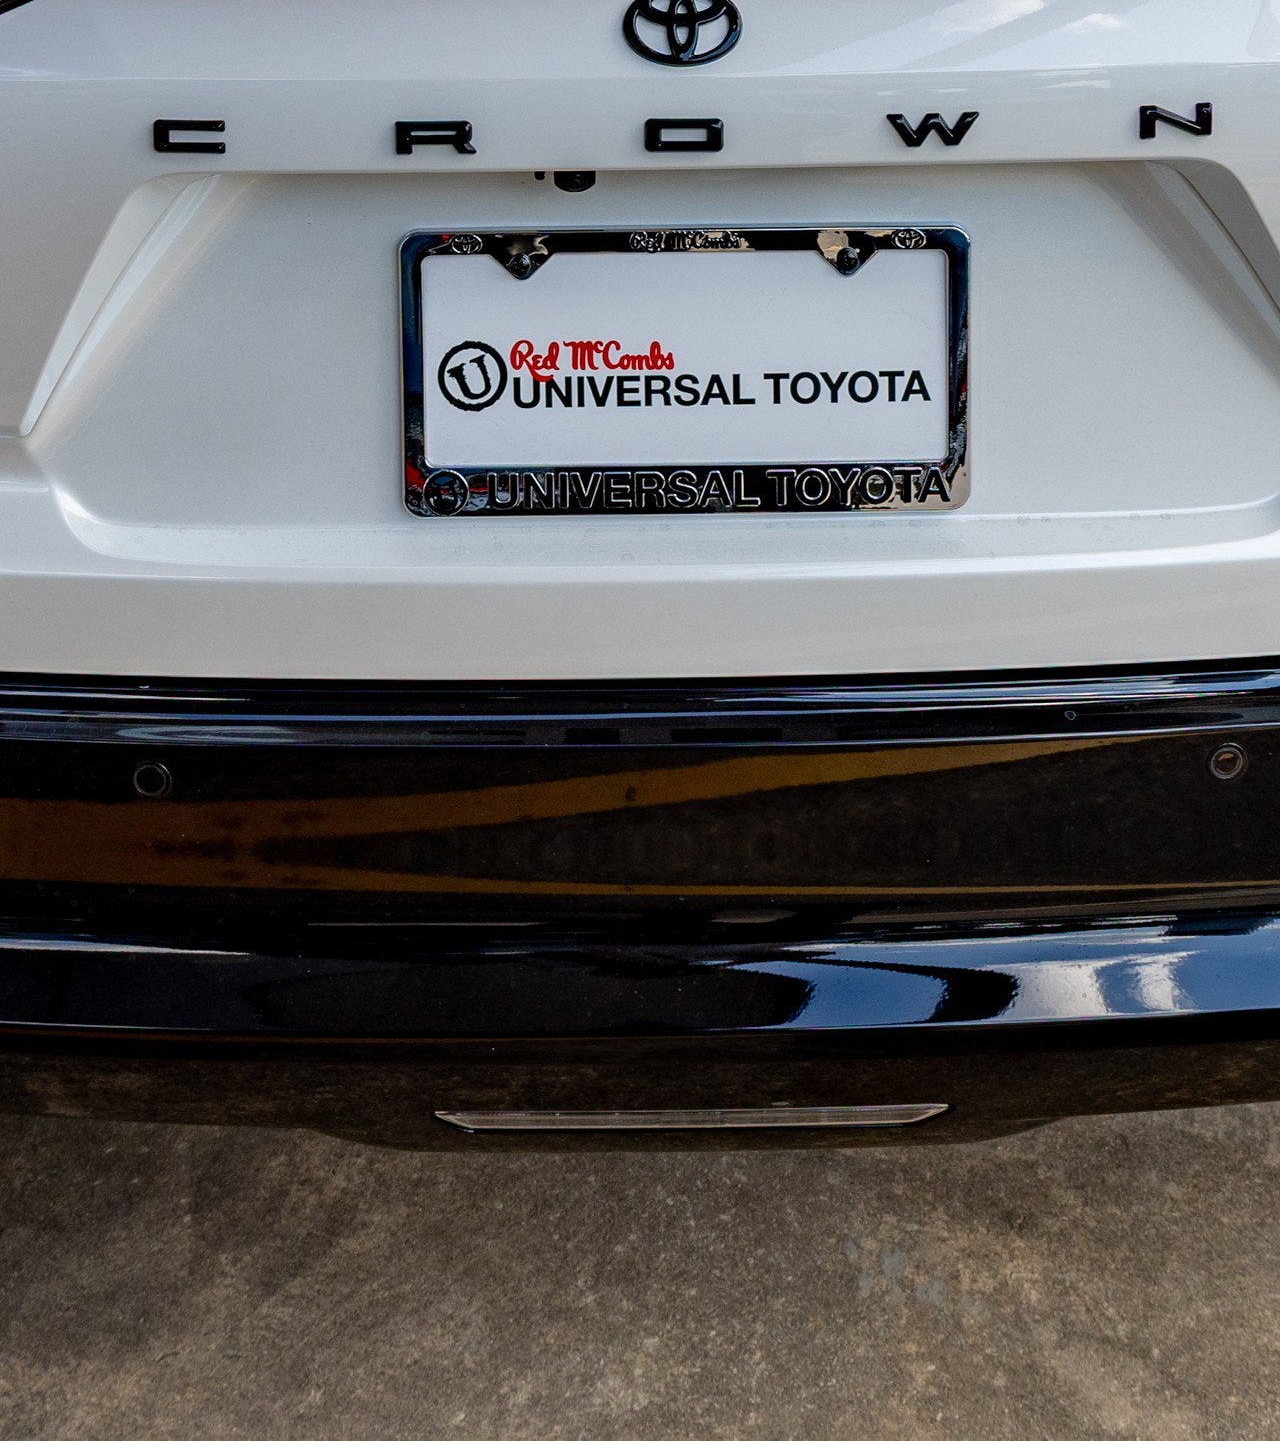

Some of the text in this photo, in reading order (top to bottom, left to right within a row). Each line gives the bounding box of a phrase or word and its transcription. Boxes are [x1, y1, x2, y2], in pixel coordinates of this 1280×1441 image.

[152, 102, 1214, 155] CROWN
[510, 340, 675, 382] Red McCombs
[512, 373, 756, 409] UNIVERSAL
[763, 370, 932, 404] TOYOTA
[486, 466, 953, 510] UNIVERSAL TOYOTA
